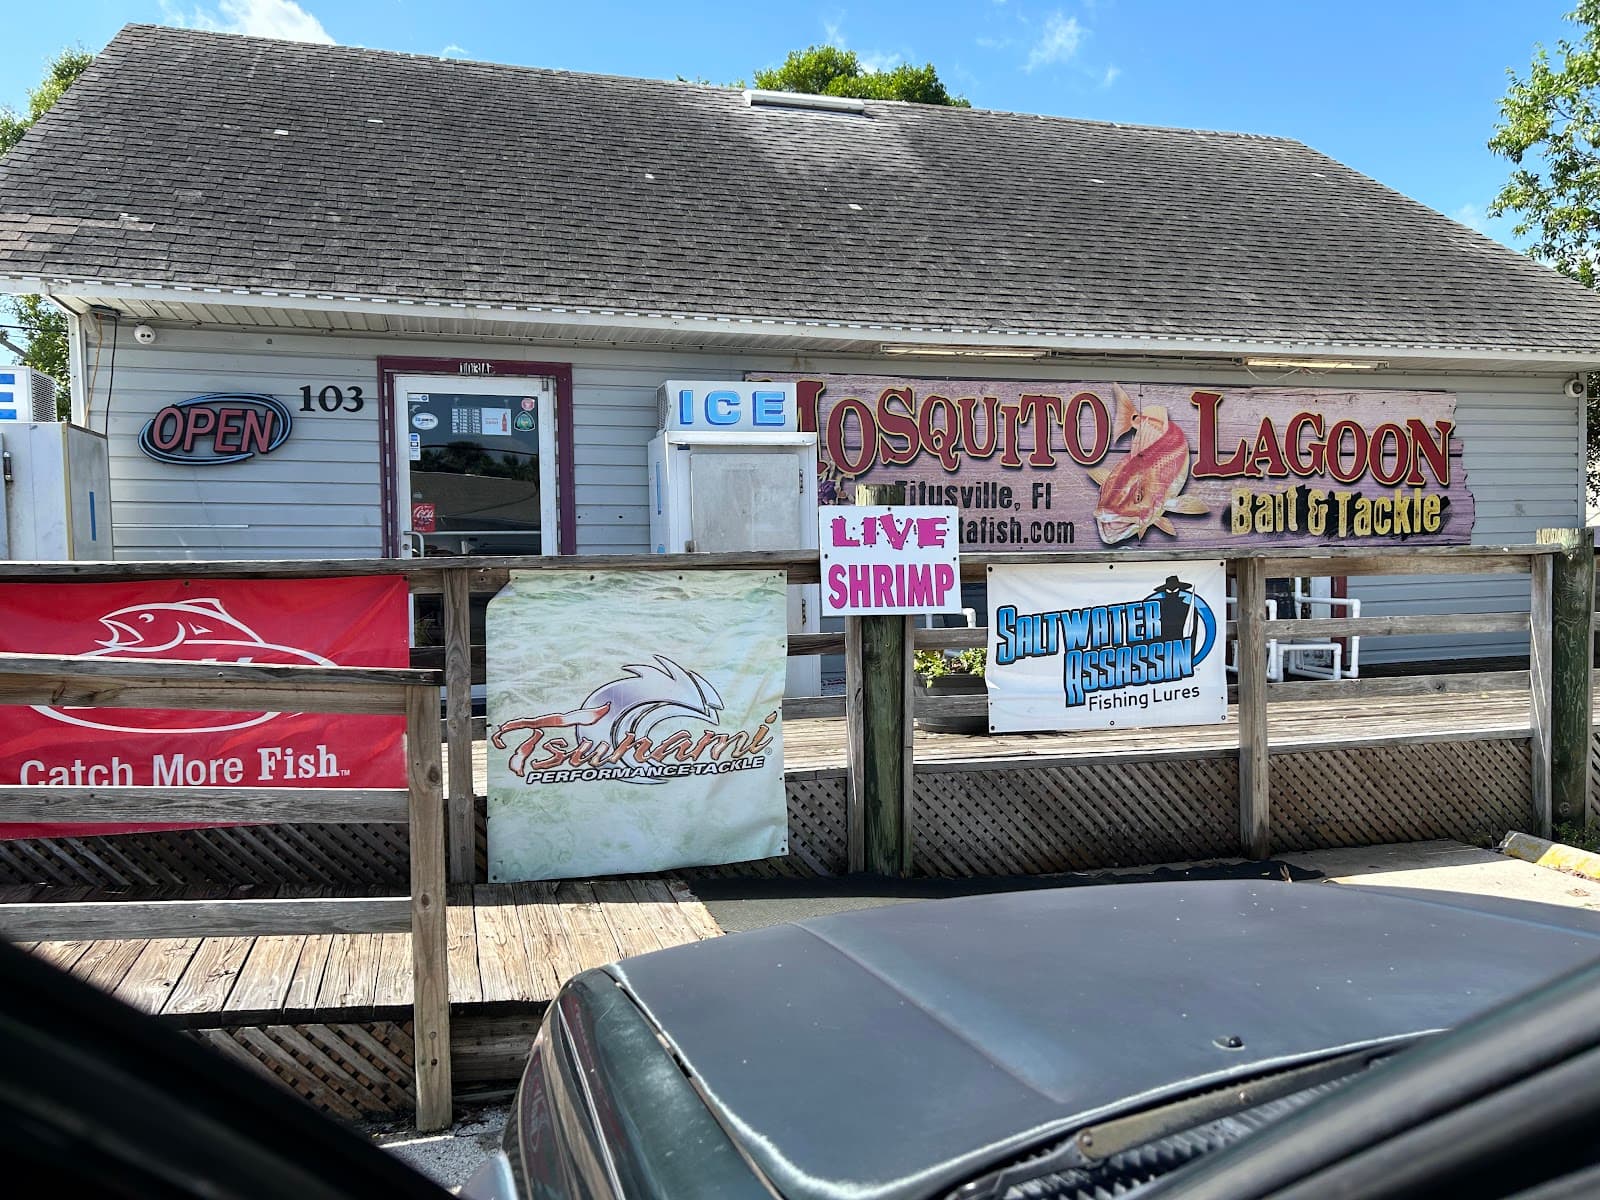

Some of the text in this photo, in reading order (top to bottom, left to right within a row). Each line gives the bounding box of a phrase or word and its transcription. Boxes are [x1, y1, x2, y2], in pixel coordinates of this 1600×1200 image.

[299, 385, 364, 412] 103
[679, 390, 786, 426] ICE
[152, 405, 276, 453] OPEN
[1191, 390, 1455, 486] LAGOON
[831, 514, 948, 550] LIVE
[959, 516, 1075, 544] tafish.com
[1231, 485, 1441, 537] Bait & Tackle
[828, 563, 954, 609] SHRIMP
[996, 600, 1162, 665] SALTWATER
[1064, 637, 1194, 707] ASSASSIN
[1089, 686, 1200, 711] Fishing Lures
[491, 702, 777, 777] Tsunami
[20, 756, 133, 786] Catch
[152, 753, 243, 786] More
